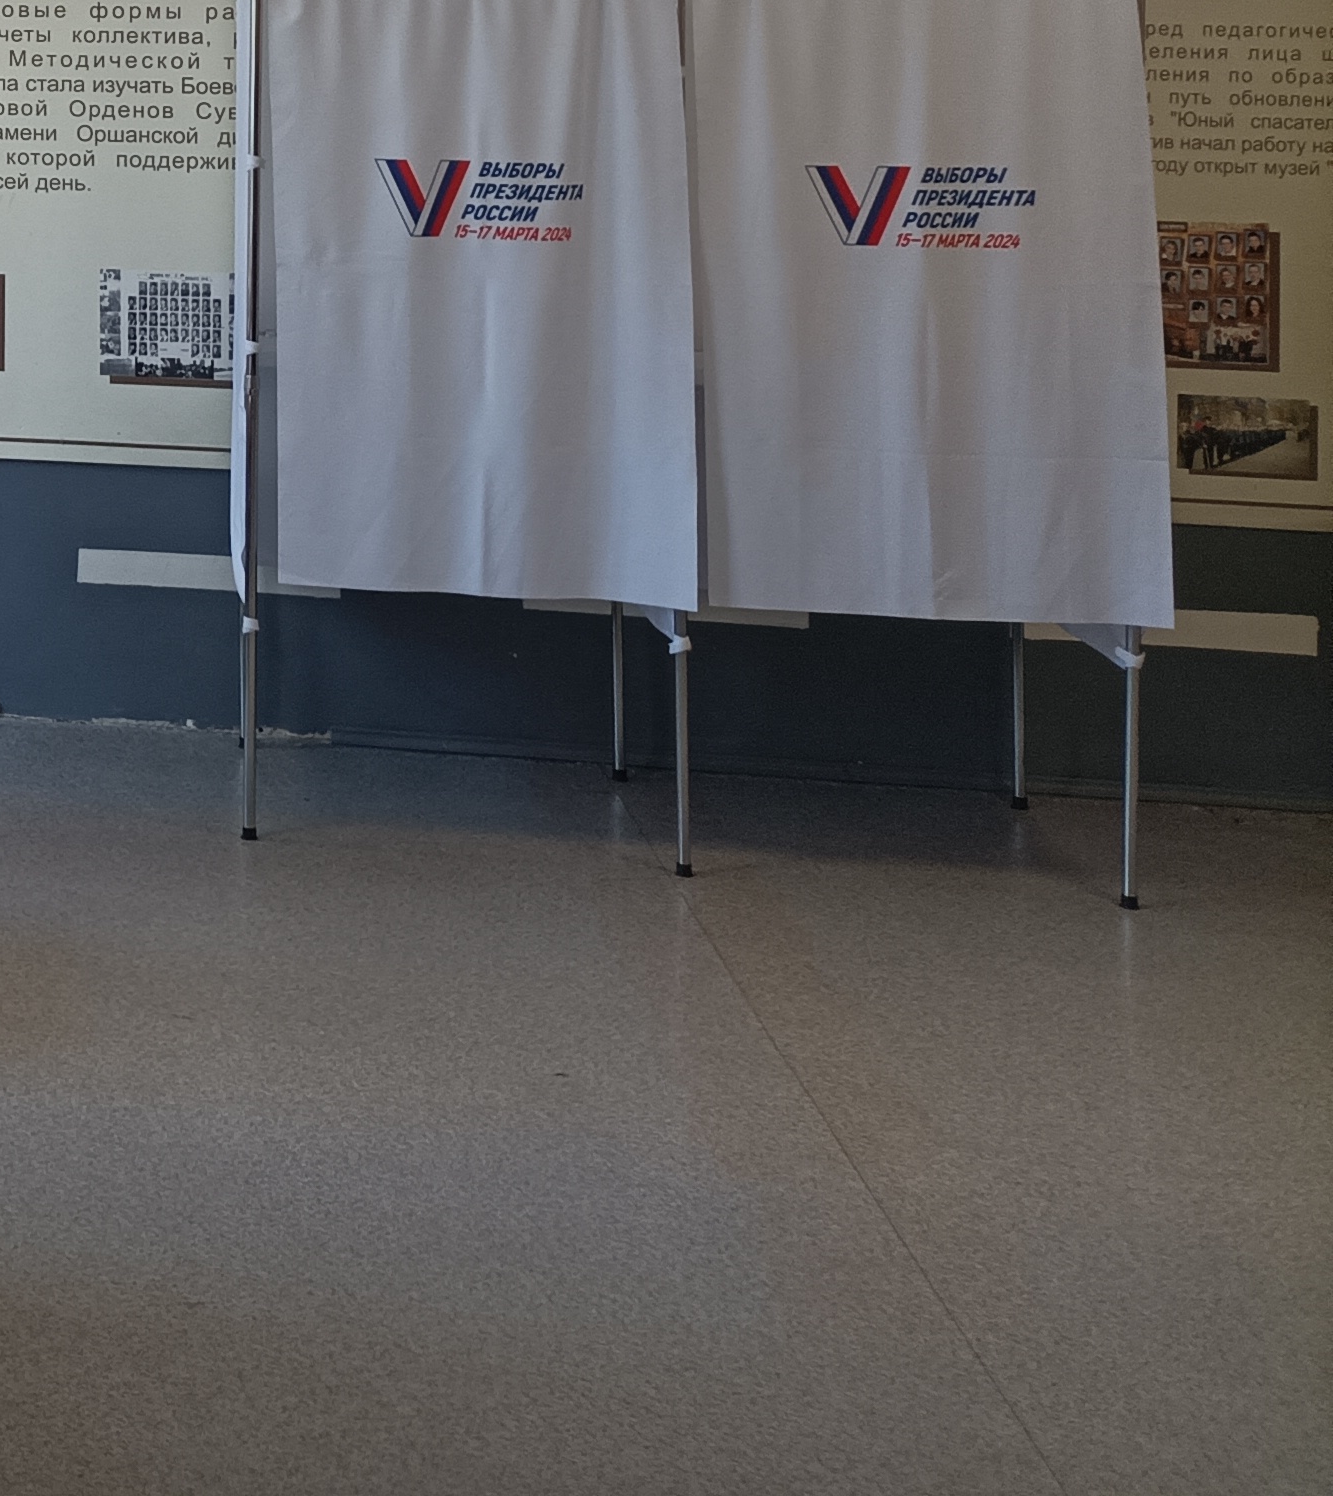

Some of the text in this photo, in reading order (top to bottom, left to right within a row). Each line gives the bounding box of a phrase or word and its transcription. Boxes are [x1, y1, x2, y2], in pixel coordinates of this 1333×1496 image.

[89, 1, 182, 24] формы
[72, 29, 211, 48] коллектива,
[8, 49, 200, 71] Методической
[25, 78, 85, 93] стала
[92, 79, 174, 98] изучать
[68, 99, 174, 122] Орденов
[76, 124, 199, 147] Оршанской
[6, 149, 96, 171] которой
[479, 161, 565, 179] ВЫБОРЫ
[921, 167, 1008, 184] ВЫБОРЫ
[34, 177, 92, 194] день.
[470, 183, 584, 203] ПРЕЗИДЕНТА
[911, 189, 1037, 209] ПРЕЗИДЕНТА
[461, 204, 539, 222] РОССИИ
[902, 211, 980, 229] РОССИИ
[493, 226, 540, 242] МАРТА
[541, 227, 572, 242] 2024
[936, 234, 981, 249] МАРТА
[983, 234, 1021, 249] 2024
